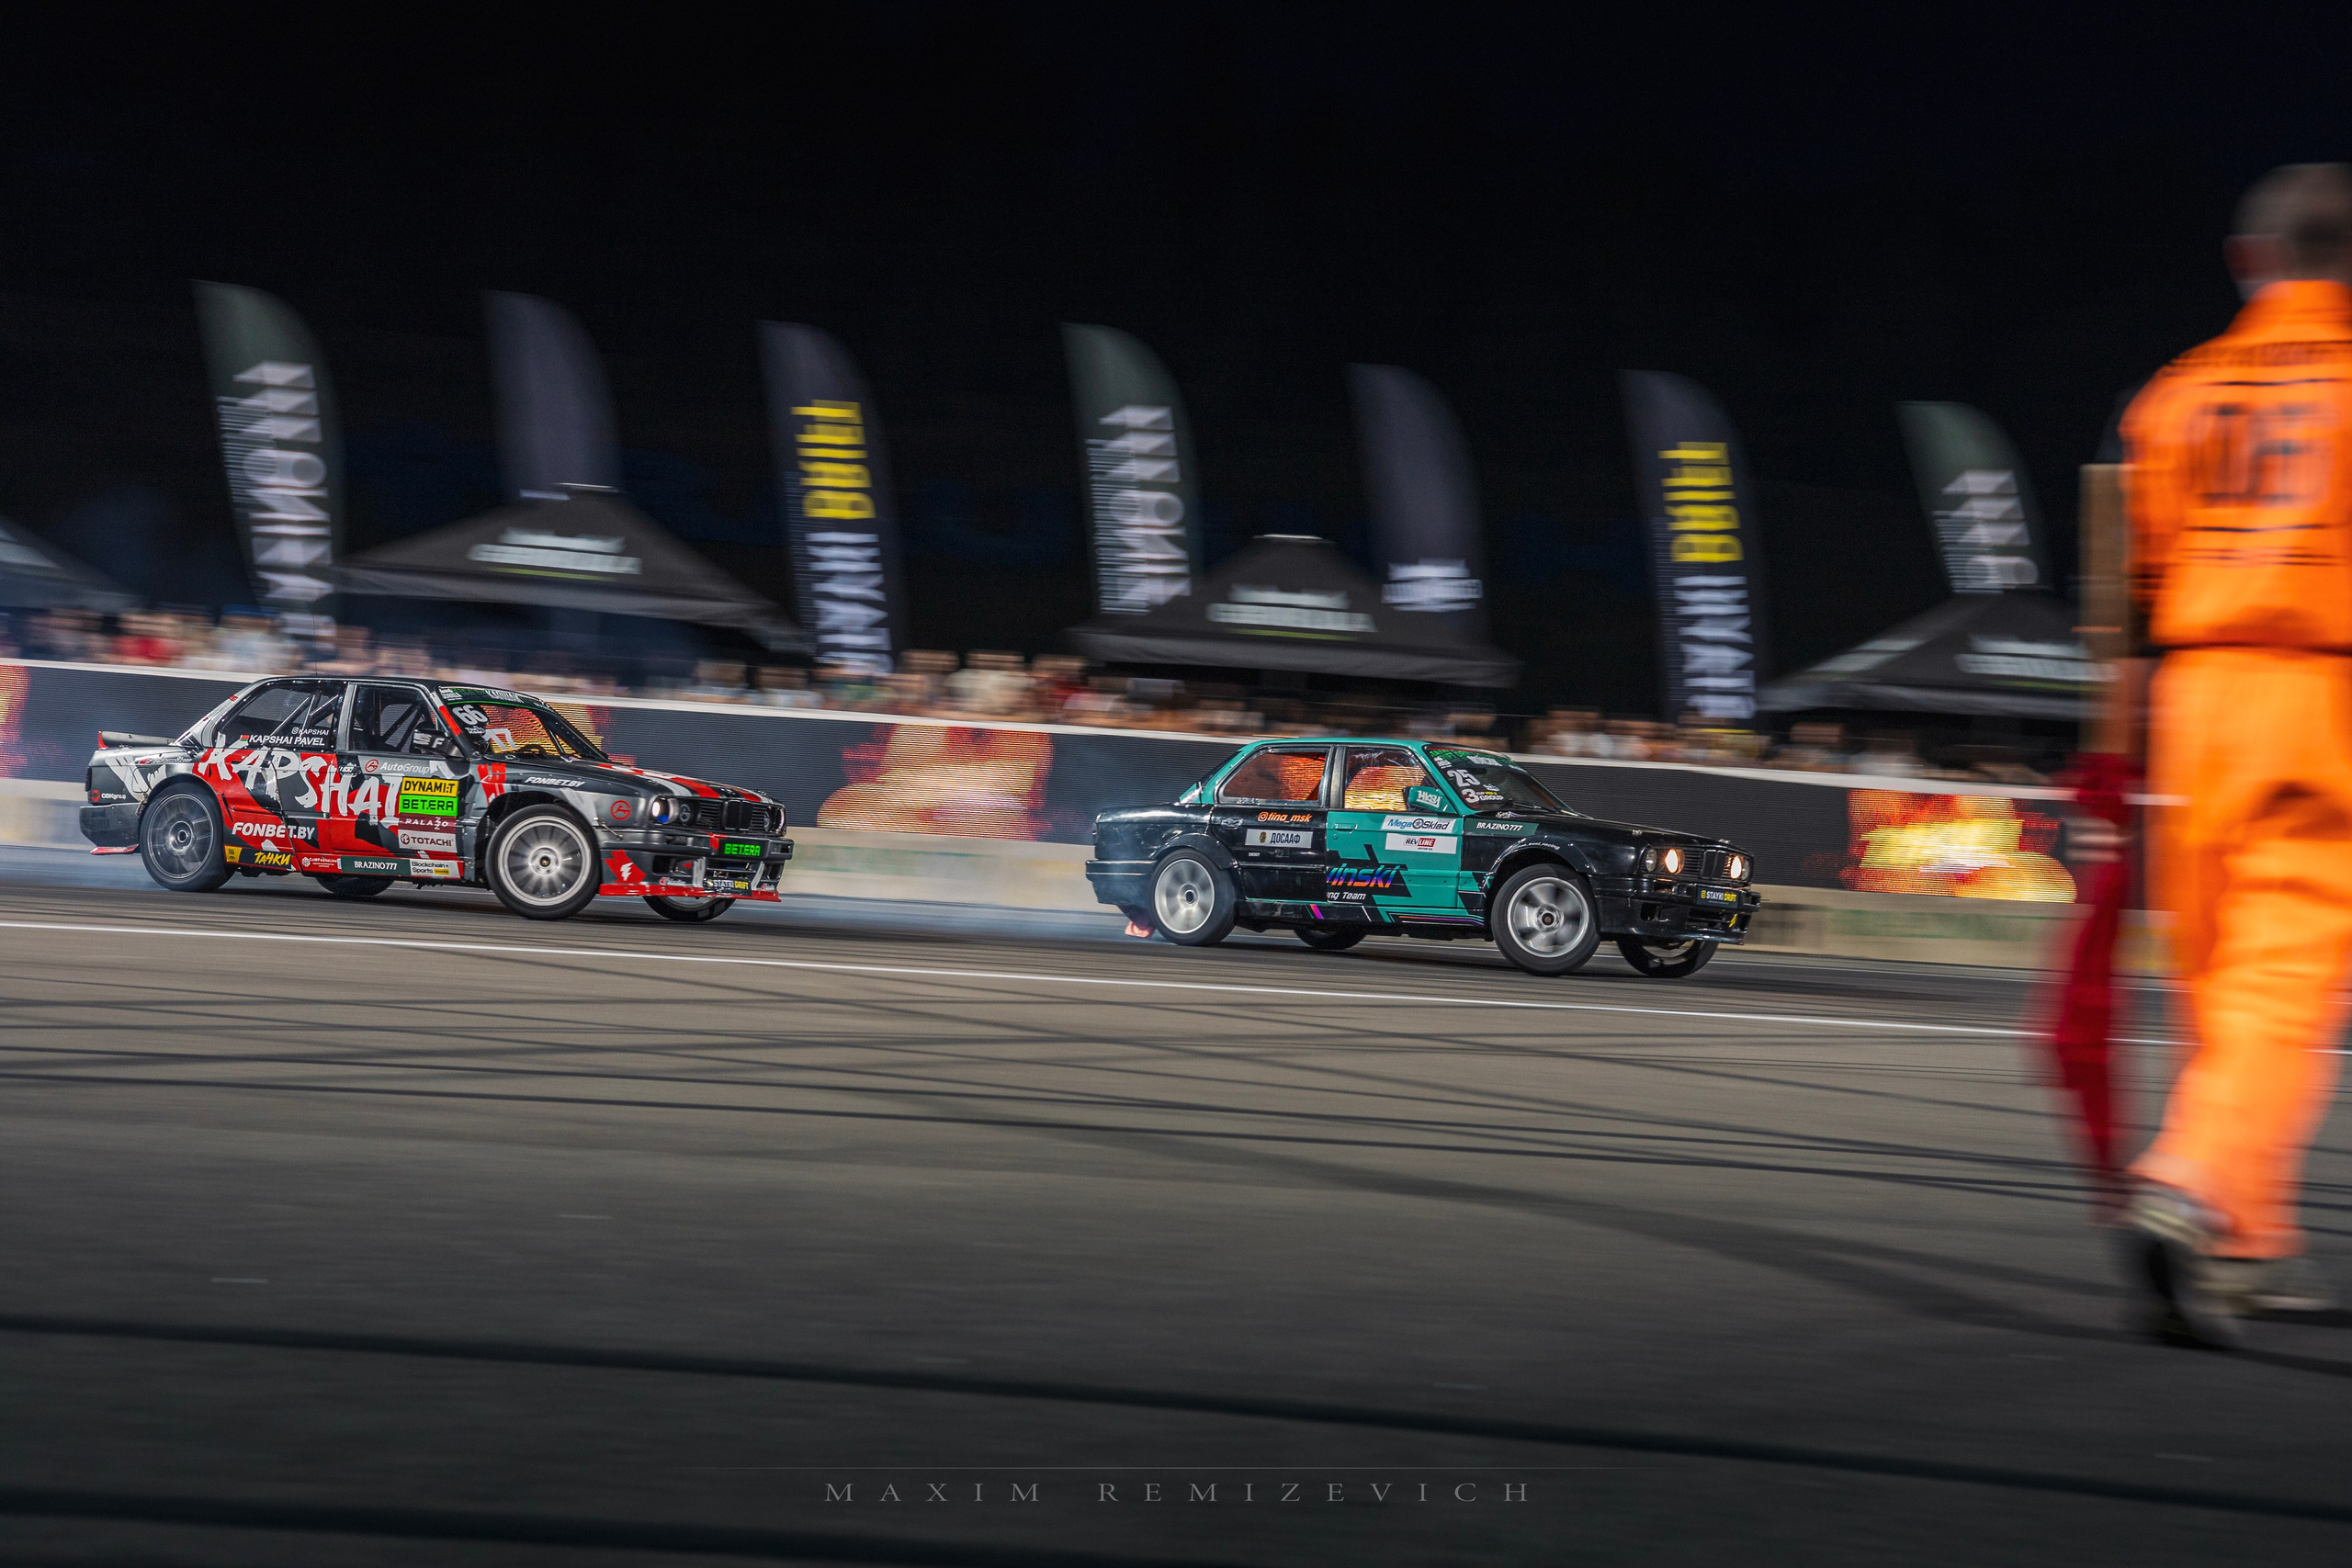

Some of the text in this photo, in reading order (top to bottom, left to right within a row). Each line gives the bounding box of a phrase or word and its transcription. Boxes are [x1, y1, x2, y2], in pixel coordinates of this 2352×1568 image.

[452, 704, 488, 726] 66
[249, 735, 325, 746] KAPSHAI PAVEL
[379, 761, 430, 774] AutoGroup
[198, 732, 405, 829] KAPSHAI
[525, 776, 585, 788] FONBET.BY
[1447, 769, 1481, 787] 25
[1462, 789, 1480, 803] 3
[1387, 818, 1450, 830] Mega Sklad
[1476, 822, 1522, 831] BRAZINO777
[232, 822, 315, 840] FONBET.BY
[410, 836, 452, 846] TOTACHI
[1270, 832, 1301, 844] ДОСААФ
[354, 861, 397, 871] BRAZINO777
[1342, 892, 1366, 900] Team
